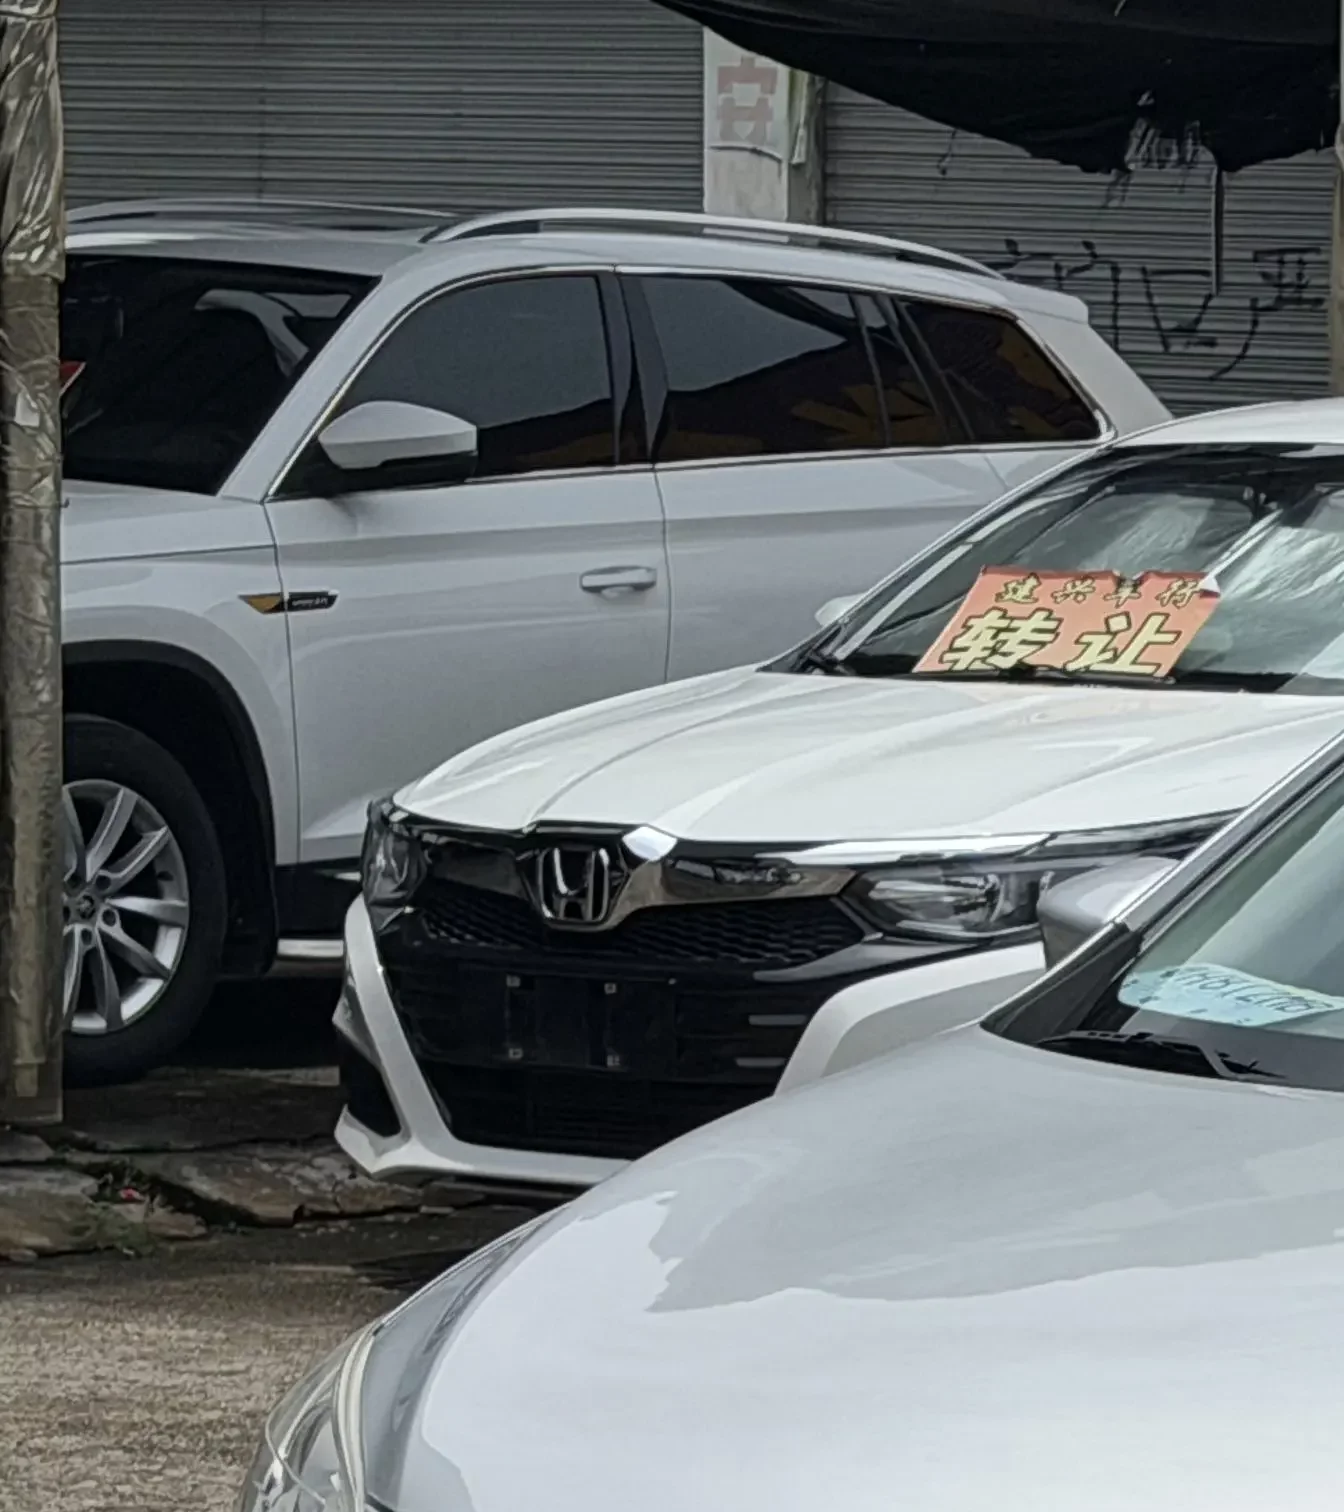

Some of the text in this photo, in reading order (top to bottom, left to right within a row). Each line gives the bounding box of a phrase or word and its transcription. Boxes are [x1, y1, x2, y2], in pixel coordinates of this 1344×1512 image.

[995, 571, 1203, 609] 建兴车行
[940, 606, 1183, 677] 转让
